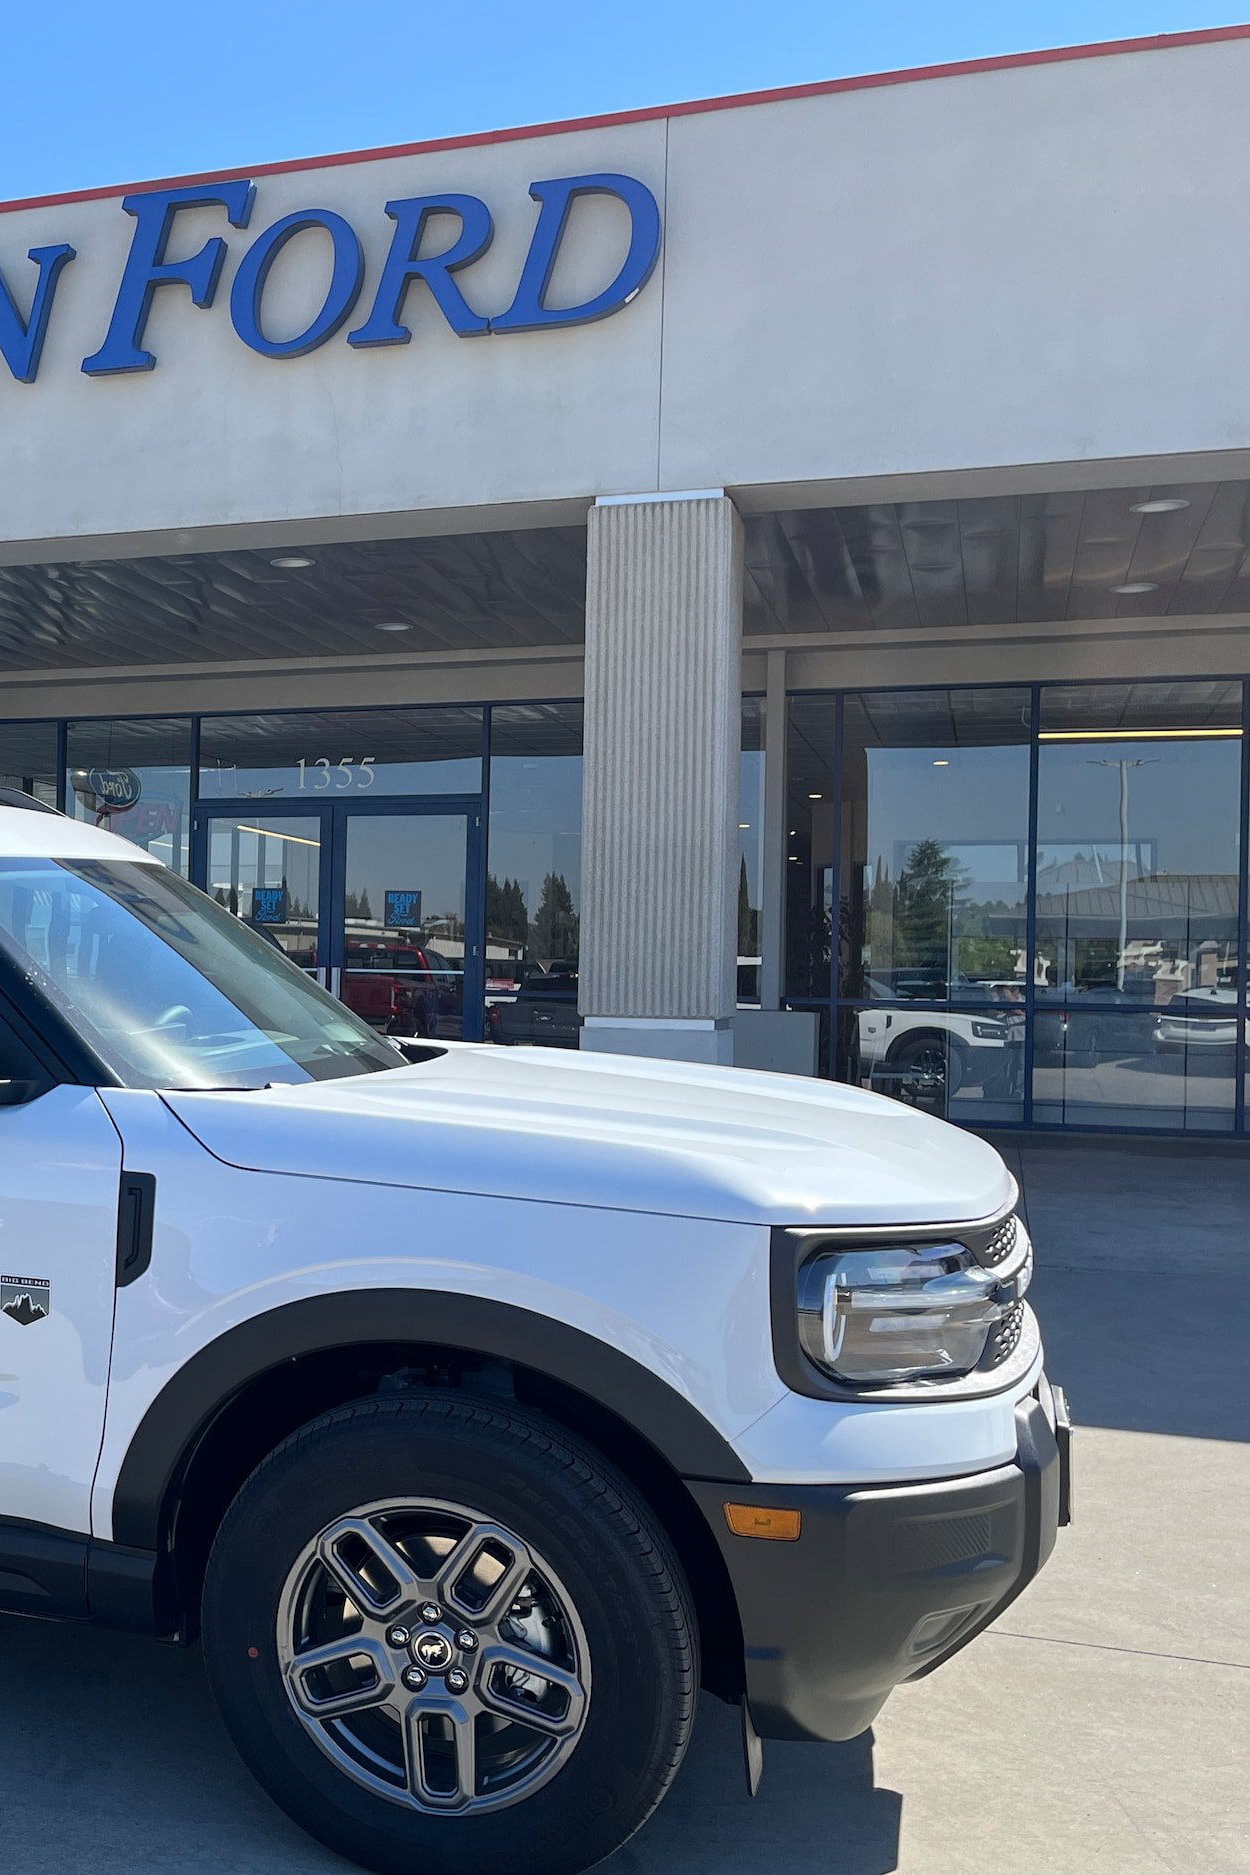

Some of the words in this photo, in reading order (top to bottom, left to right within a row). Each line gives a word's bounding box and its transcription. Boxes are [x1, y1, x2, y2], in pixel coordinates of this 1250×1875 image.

[81, 173, 661, 377] FORD
[296, 756, 376, 789] 1355
[255, 890, 283, 901] READY
[388, 893, 418, 904] READY
[261, 900, 276, 911] SET
[394, 903, 410, 914] SET
[21, 1278, 49, 1286] BEND
